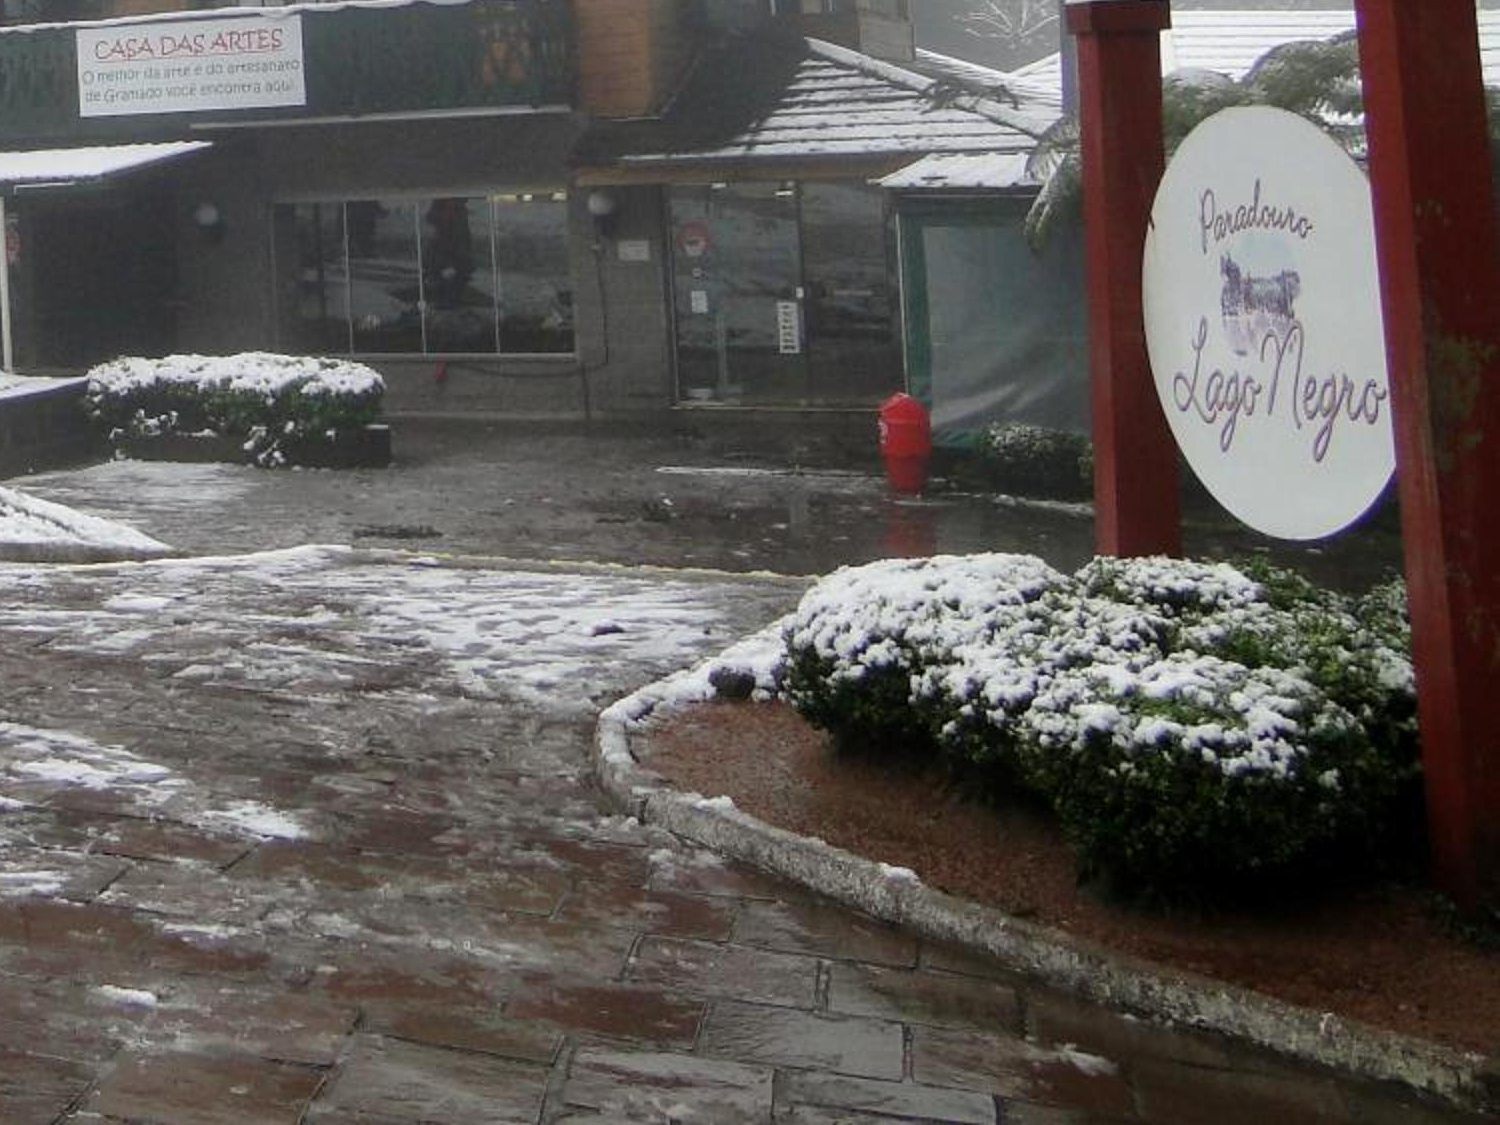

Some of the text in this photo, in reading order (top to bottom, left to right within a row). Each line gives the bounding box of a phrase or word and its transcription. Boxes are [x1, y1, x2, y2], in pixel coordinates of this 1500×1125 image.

[95, 28, 283, 61] CASA DAS ARTES
[83, 70, 94, 84] O
[97, 67, 144, 83] melhor
[164, 64, 190, 79] arte
[205, 61, 223, 76] do
[227, 58, 300, 75] artesanato
[85, 89, 101, 103] de
[199, 79, 261, 95] encontra
[1199, 178, 1313, 254] Paradouro
[1172, 316, 1387, 463] Lago Negro
